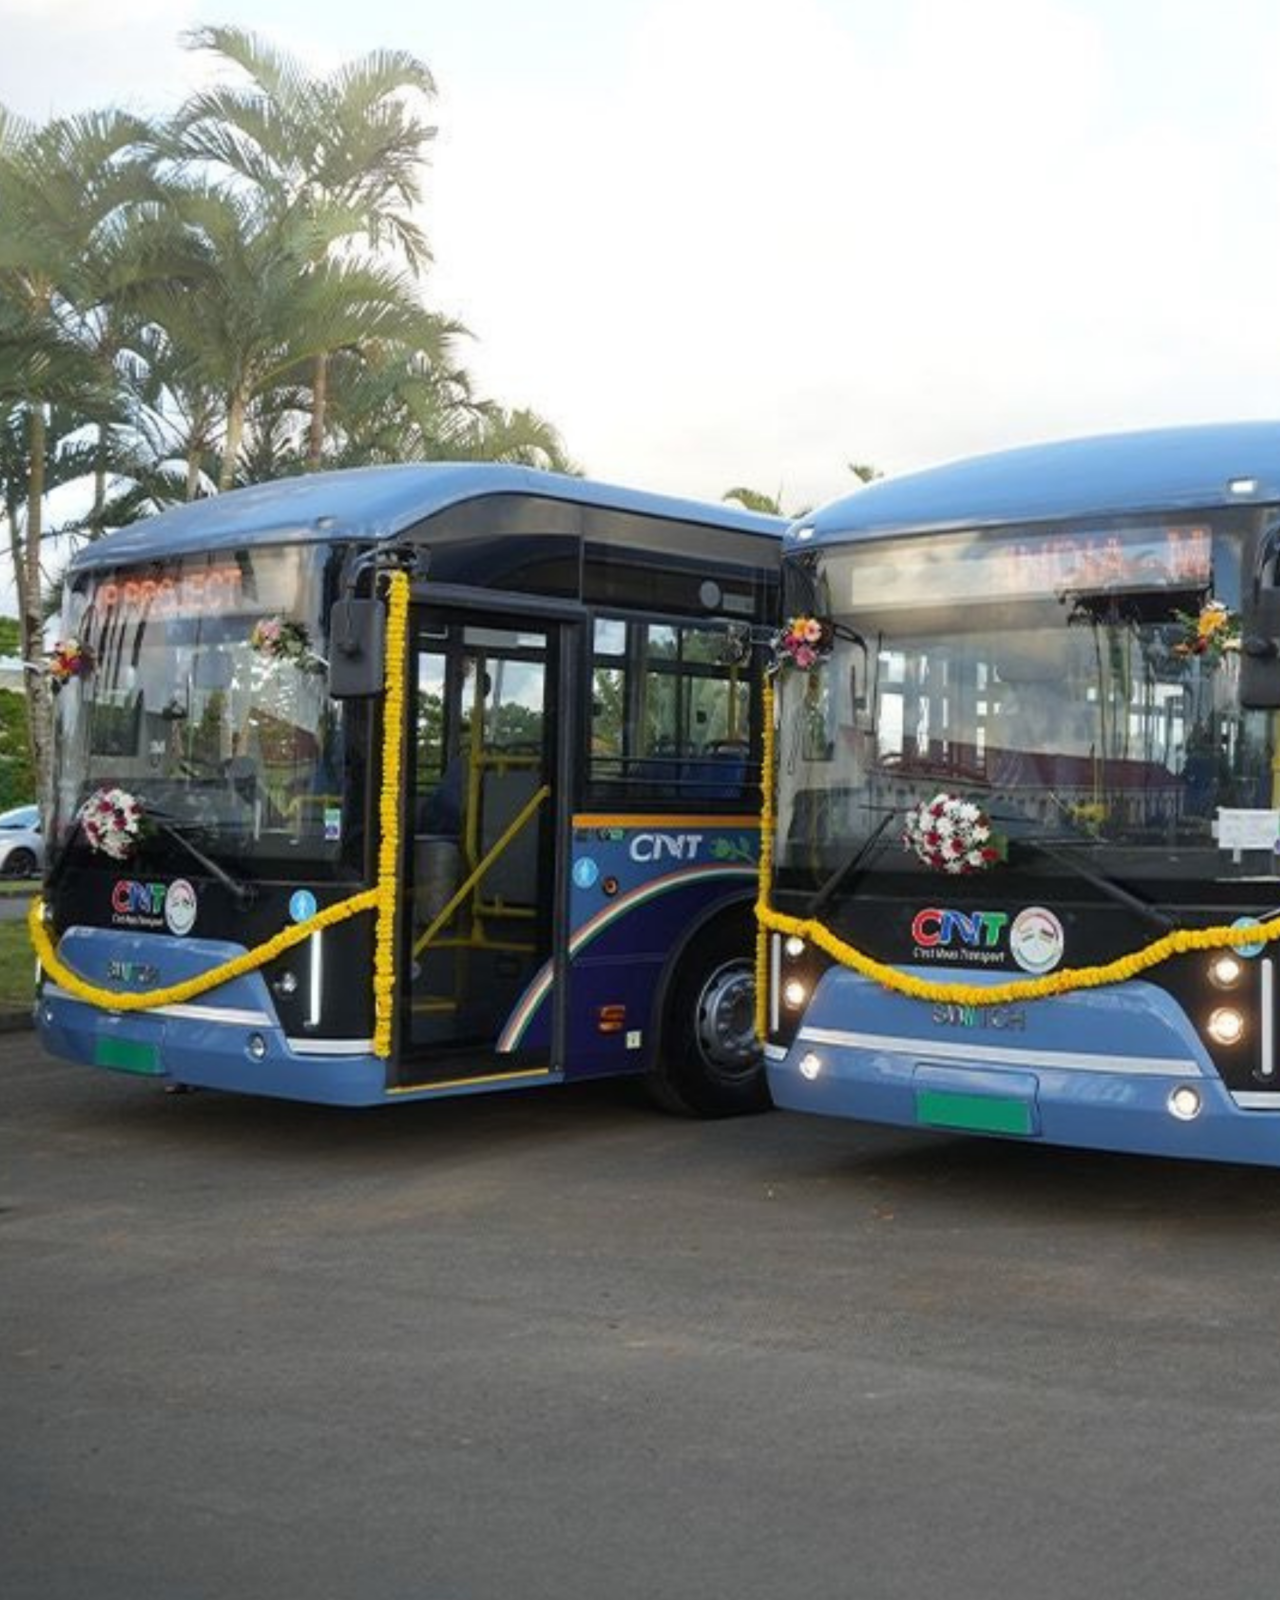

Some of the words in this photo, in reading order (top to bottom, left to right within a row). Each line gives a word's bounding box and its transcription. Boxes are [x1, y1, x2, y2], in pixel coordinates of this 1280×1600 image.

[629, 832, 703, 862] CNT
[112, 880, 166, 914] CNT
[911, 908, 1008, 947] CNT
